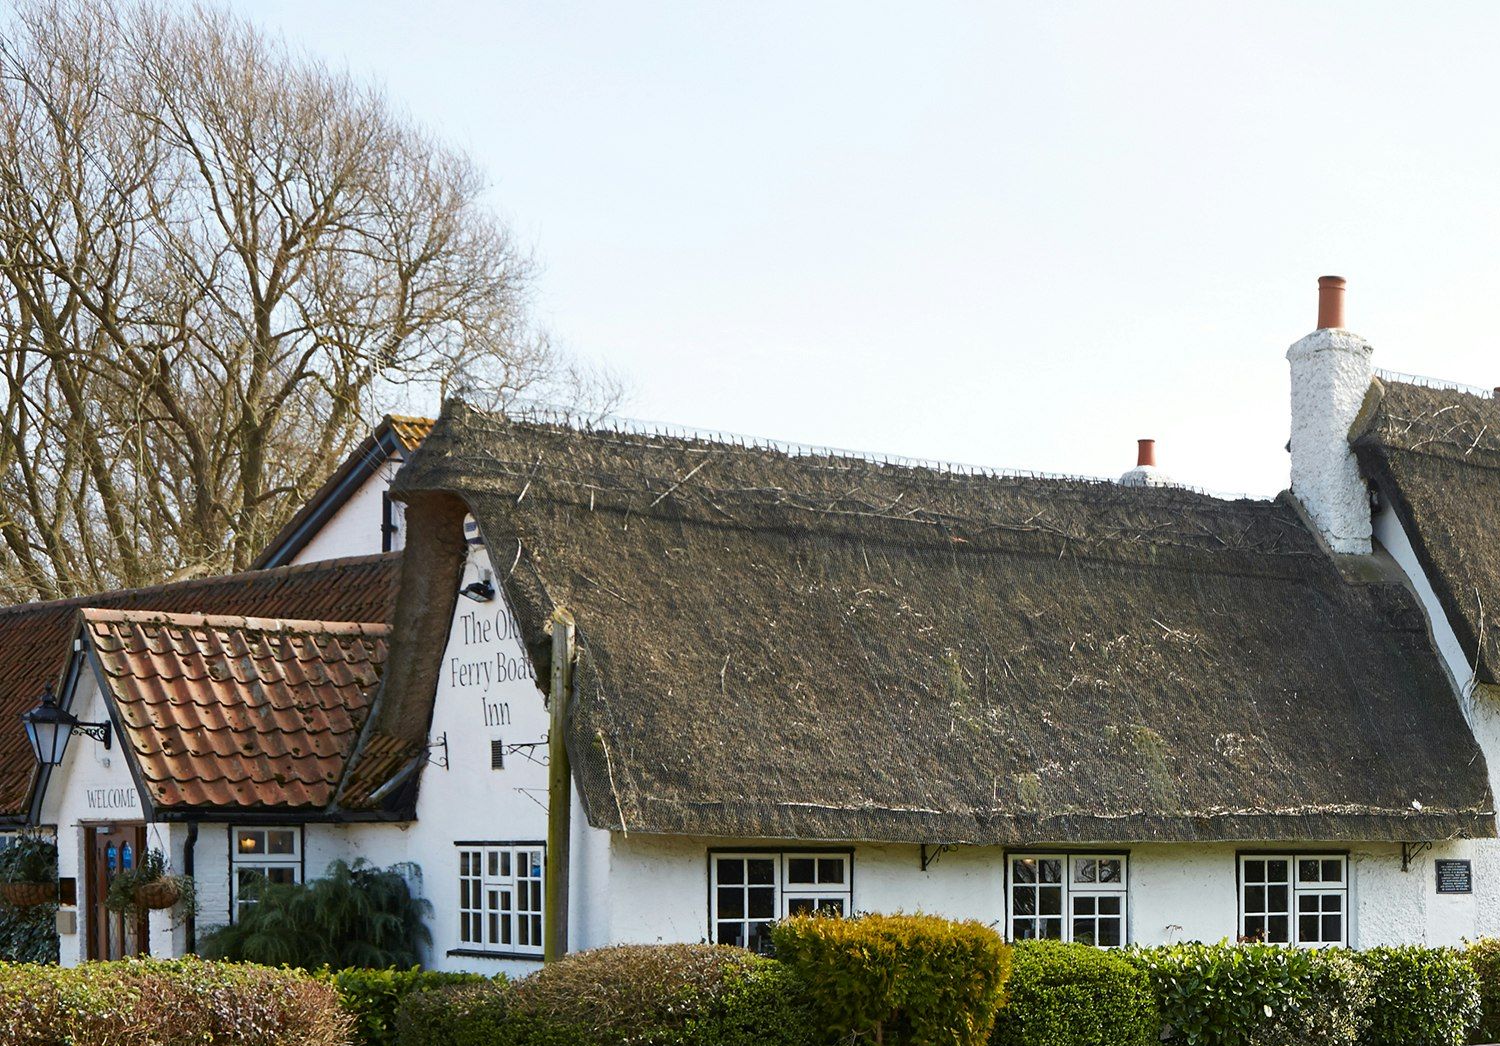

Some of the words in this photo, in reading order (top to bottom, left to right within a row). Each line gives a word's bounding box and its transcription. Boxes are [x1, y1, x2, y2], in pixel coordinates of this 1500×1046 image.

[460, 611, 492, 645] The
[451, 655, 493, 692] Ferry
[482, 697, 511, 727] Inn
[87, 788, 137, 809] WELCOME
